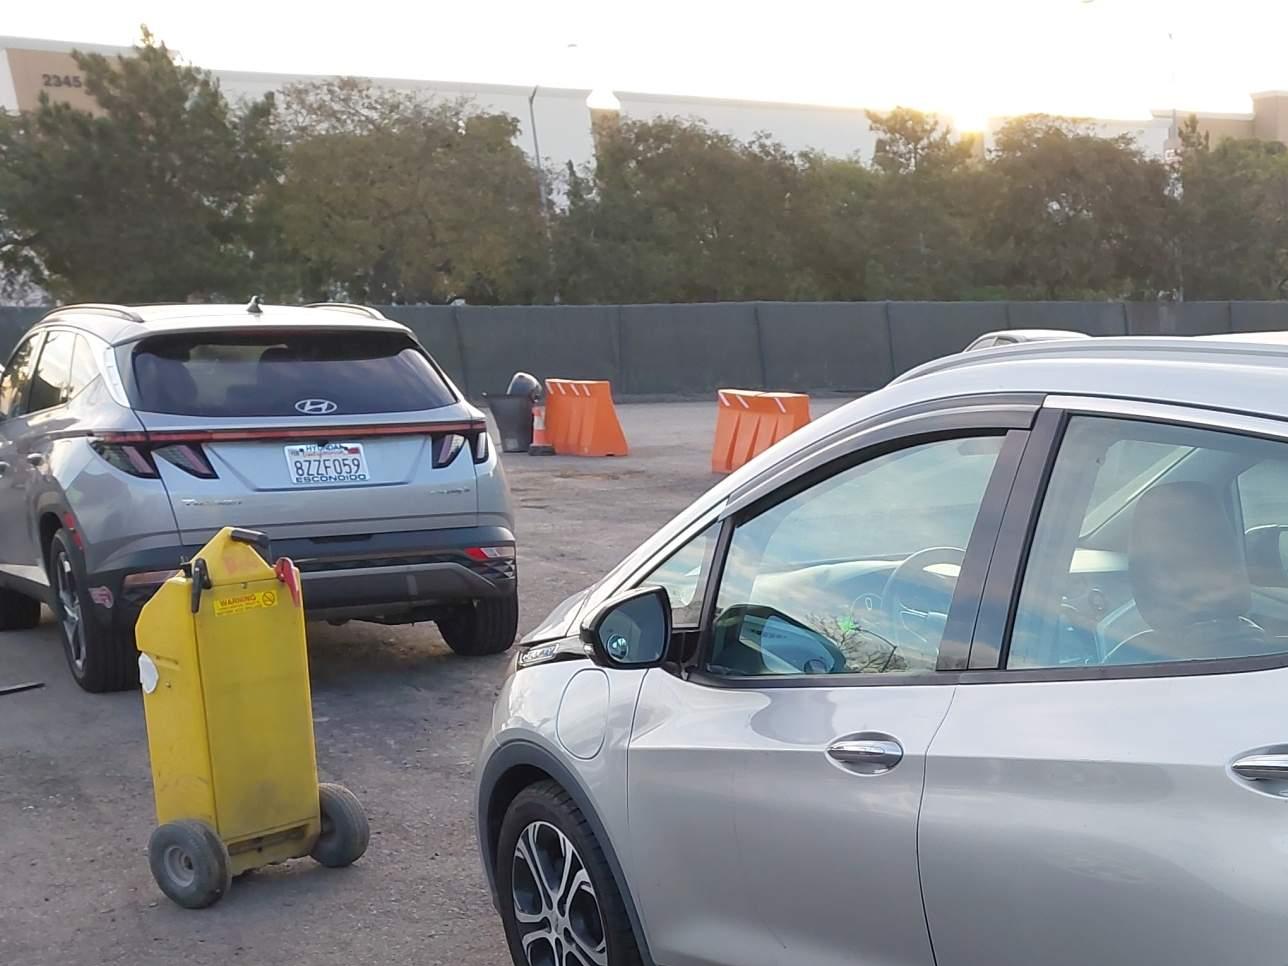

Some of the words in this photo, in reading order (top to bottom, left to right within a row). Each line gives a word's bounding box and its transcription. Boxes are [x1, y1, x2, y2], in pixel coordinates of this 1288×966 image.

[43, 73, 82, 88] 2345
[294, 459, 361, 476] 8ZZF059
[296, 474, 366, 483] ESCONDIDO
